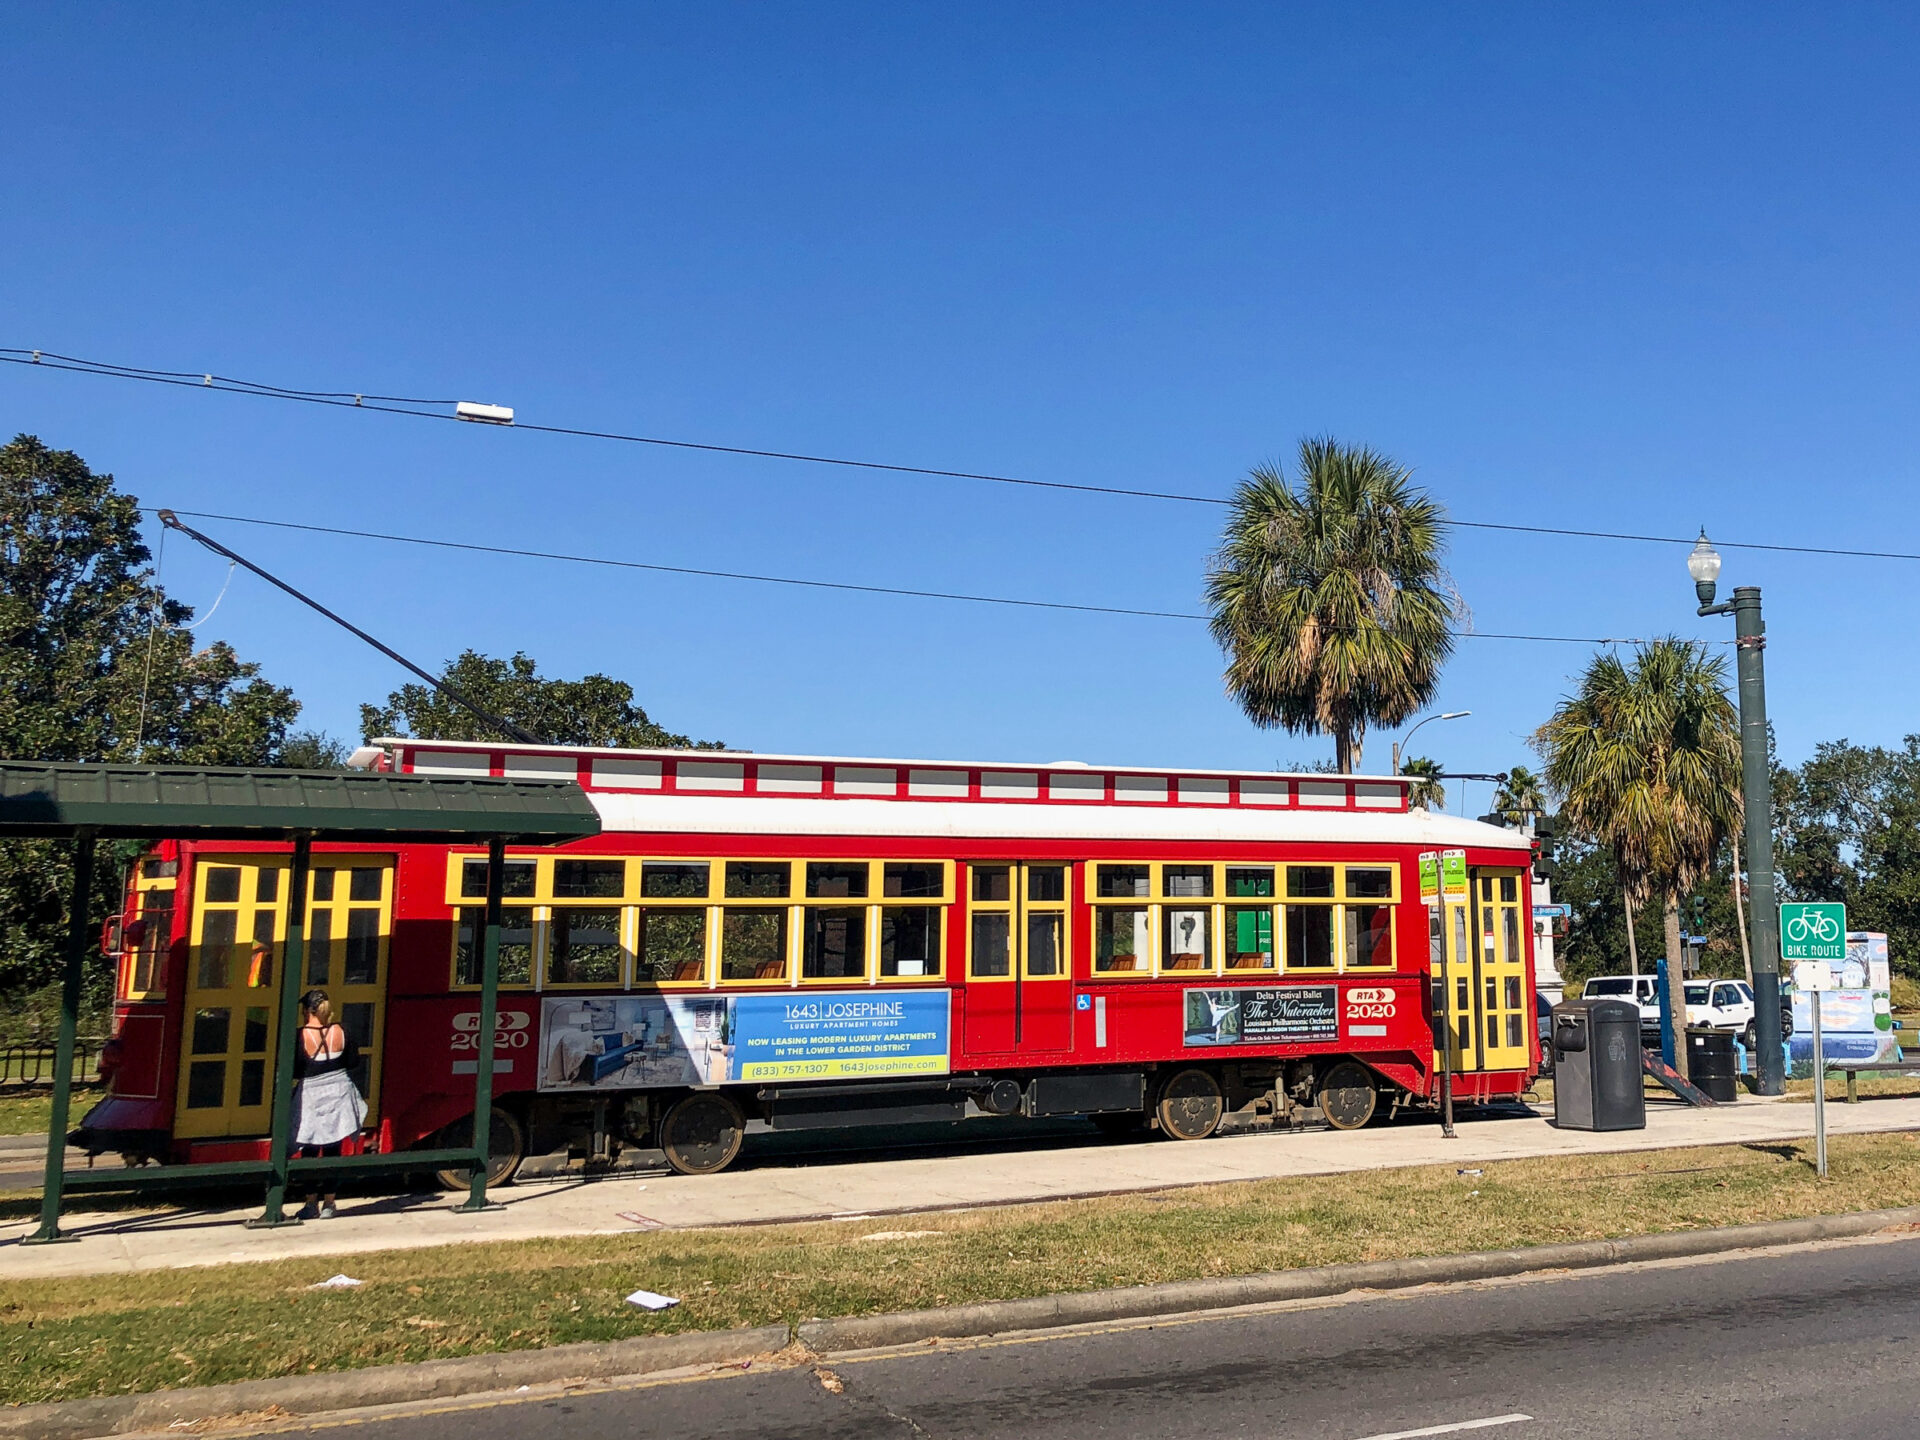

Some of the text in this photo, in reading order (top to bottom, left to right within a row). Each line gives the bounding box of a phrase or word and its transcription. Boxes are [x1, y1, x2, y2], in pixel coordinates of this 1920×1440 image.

[1787, 945, 1841, 957] BIKE ROUTE
[1256, 990, 1322, 1000] Delta Festival Ballet
[1356, 991, 1374, 1000] RTA
[785, 1001, 904, 1019] 1643 JOSEPHINE
[1243, 999, 1335, 1019] The Nutcracker
[1346, 1003, 1396, 1019] 2020
[823, 1021, 869, 1029] APARTMENT
[1244, 1017, 1335, 1027] Louisiana Philharmonic Orchestra
[747, 1032, 937, 1046] NOW LEASING MODERN LUXURY APARTMENTS
[775, 1043, 911, 1056] IN THE LOWER GARDEN DISTRICT
[752, 1060, 937, 1077] (833) 757-1307 1643josephine.com
